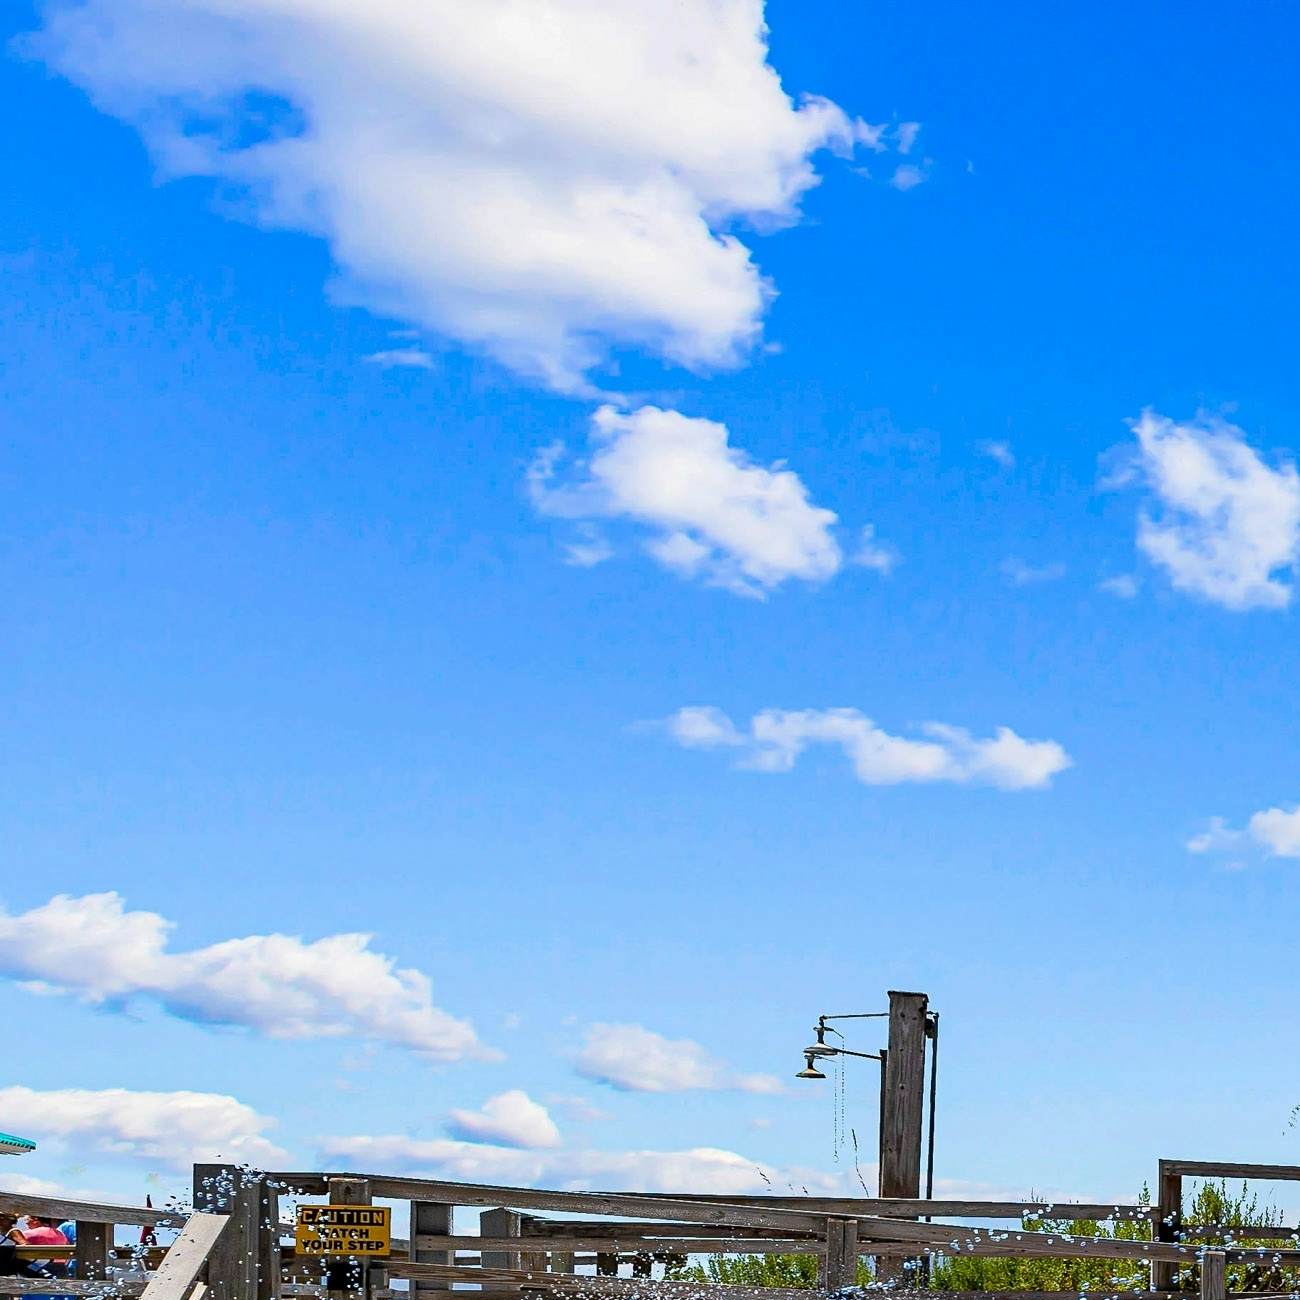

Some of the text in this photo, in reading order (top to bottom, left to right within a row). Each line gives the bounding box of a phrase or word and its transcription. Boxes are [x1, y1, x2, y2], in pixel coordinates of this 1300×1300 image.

[302, 1210, 383, 1224] CAUTION
[302, 1240, 384, 1251] YOUR STEP
